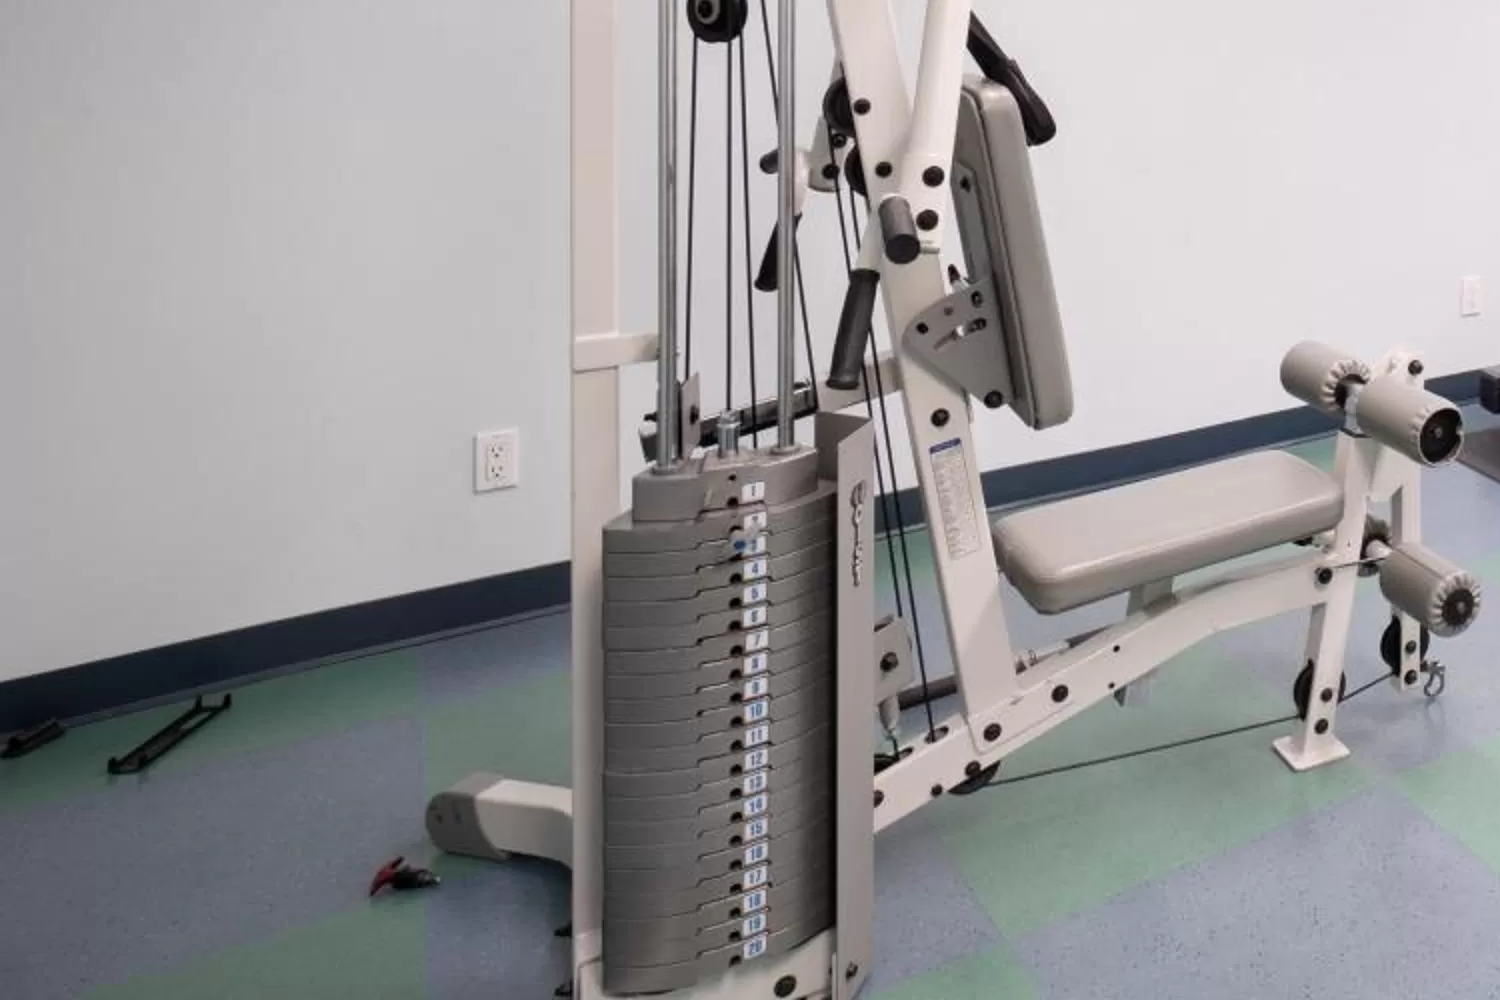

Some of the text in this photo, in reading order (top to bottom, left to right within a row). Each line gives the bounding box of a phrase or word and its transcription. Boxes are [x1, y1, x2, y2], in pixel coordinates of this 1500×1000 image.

[750, 703, 763, 718] 10
[750, 728, 763, 743] 11
[750, 751, 763, 766] 12
[749, 869, 762, 884] 17
